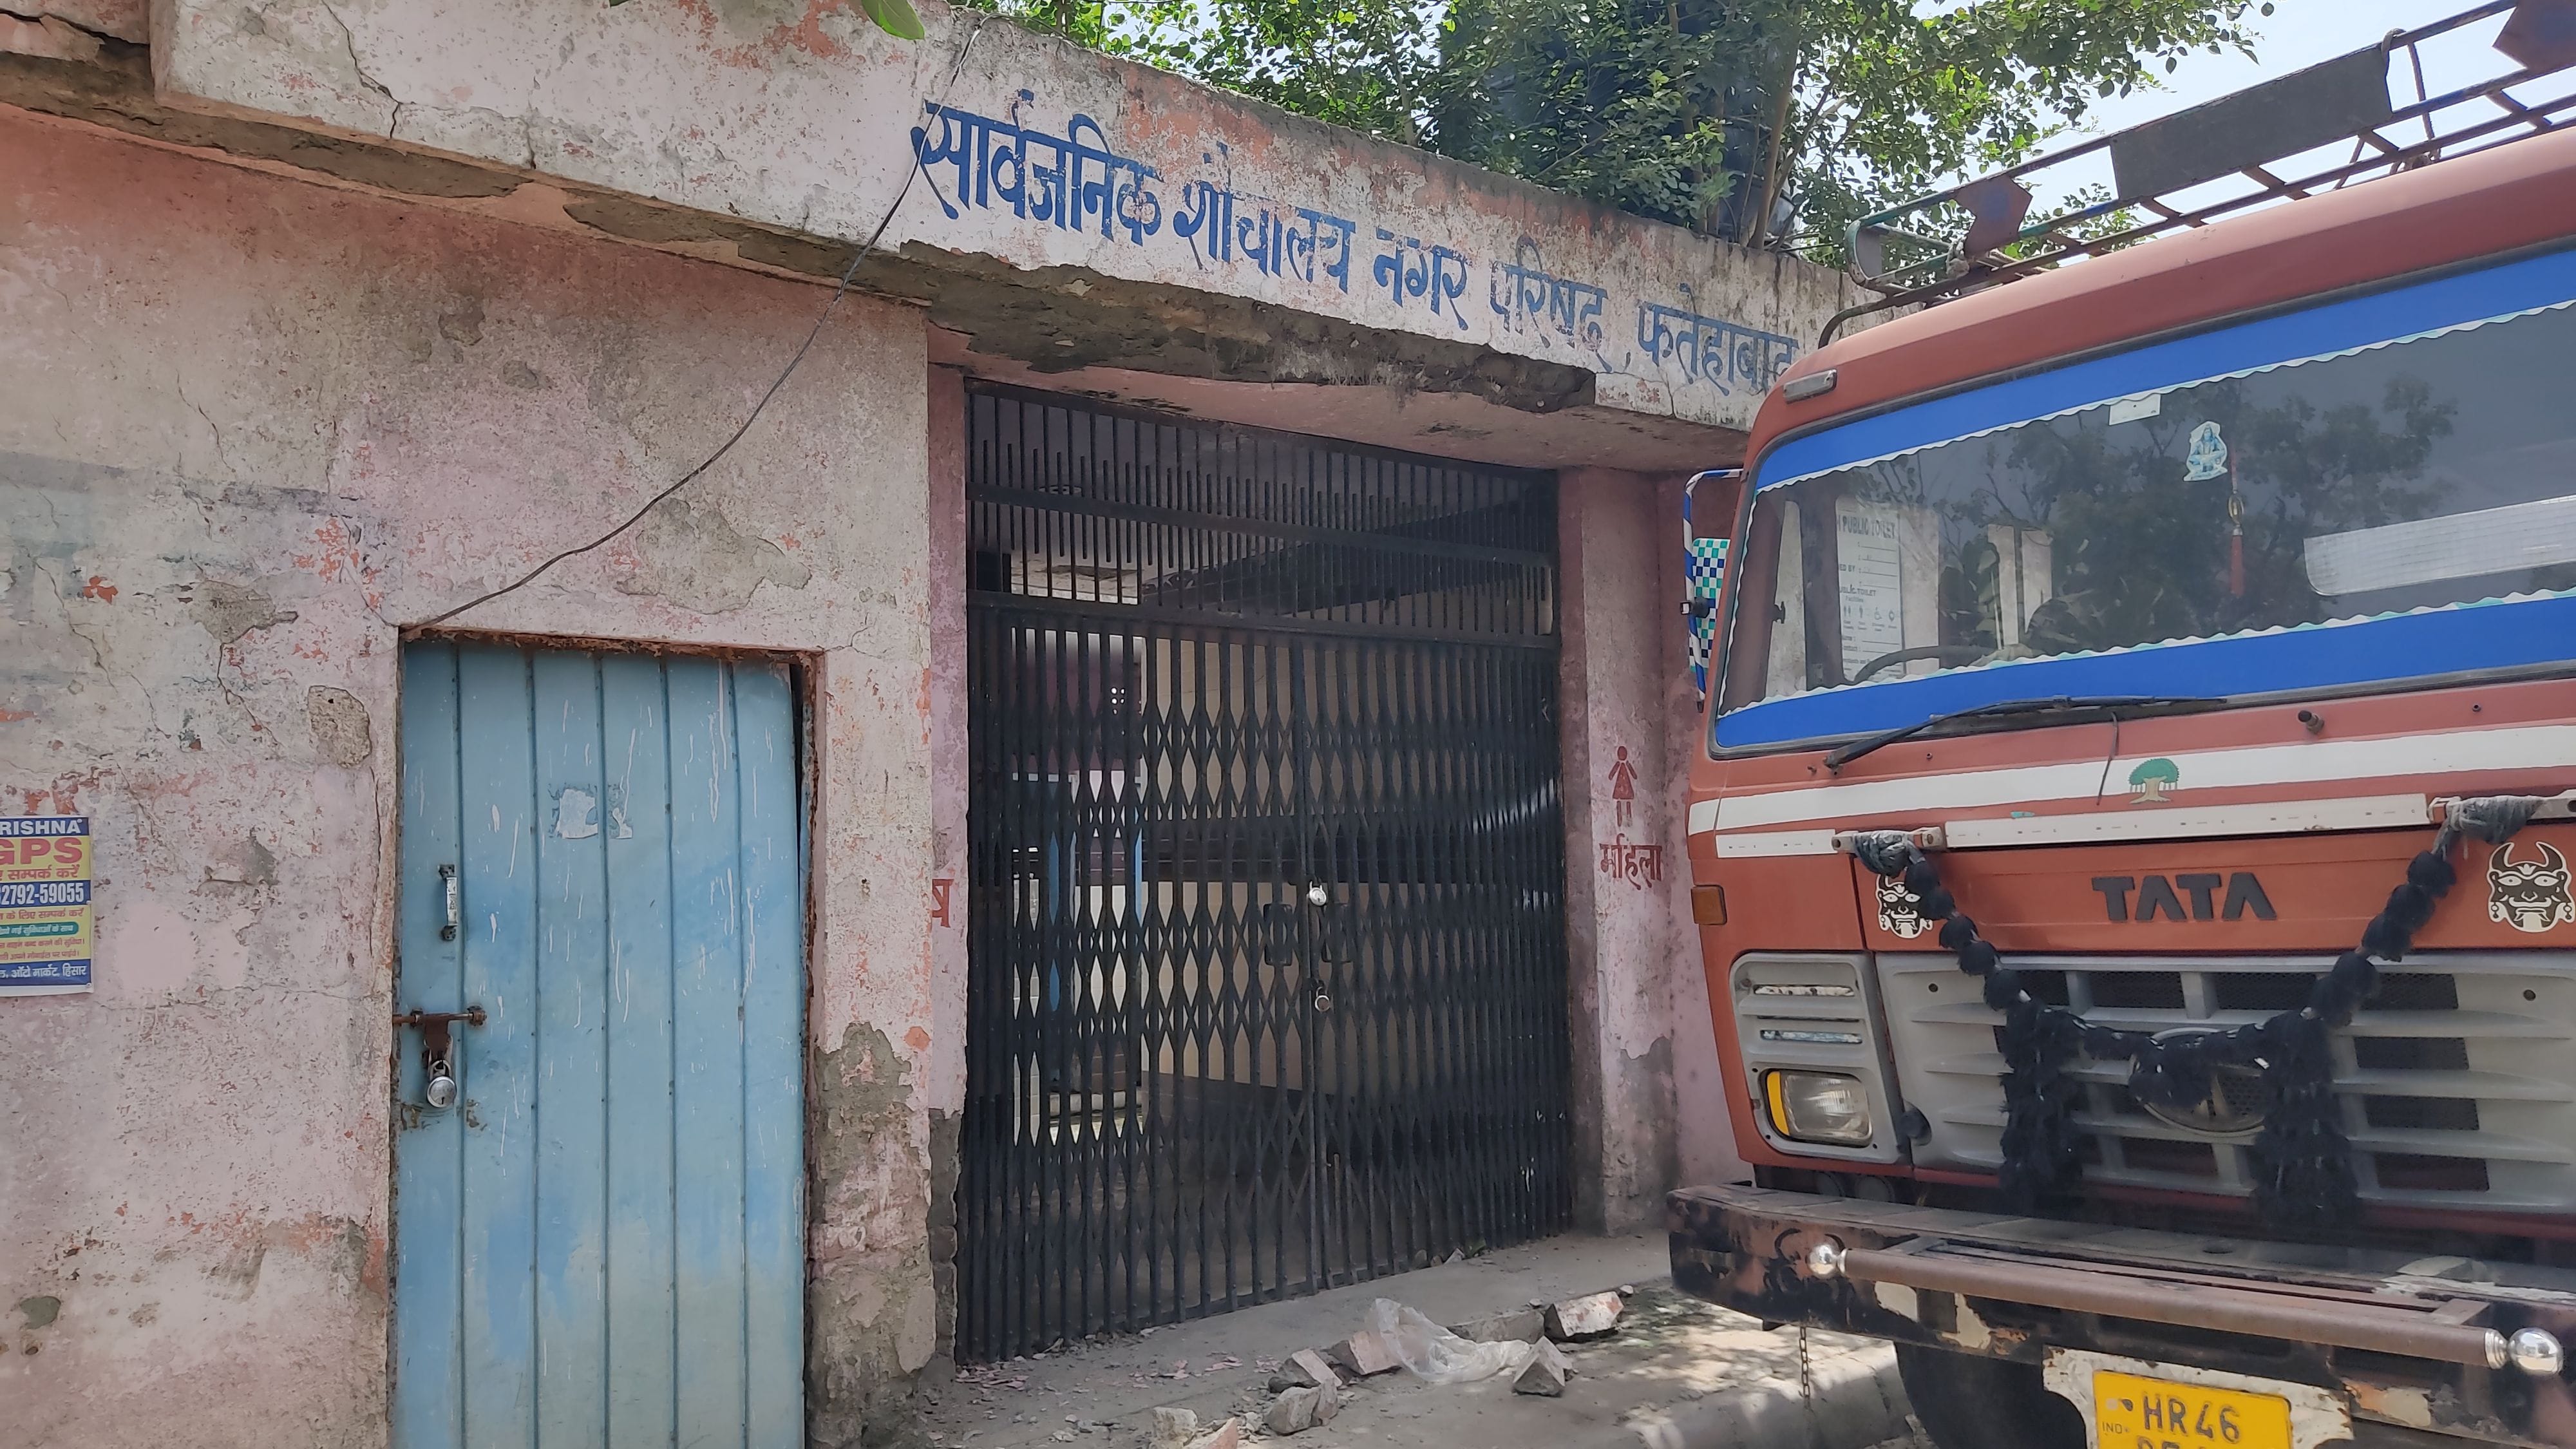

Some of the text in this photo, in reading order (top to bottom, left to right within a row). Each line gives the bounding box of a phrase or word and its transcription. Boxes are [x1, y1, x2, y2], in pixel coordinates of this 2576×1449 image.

[911, 89, 1163, 246] सार्वजनिक
[1373, 225, 1473, 331] नगर
[1842, 516, 1868, 536] PUBLIC
[8, 864, 52, 880] सम्पर्क
[56, 864, 80, 878] करें
[1599, 833, 1663, 891] महिला
[0, 884, 84, 905] 2792-59055
[2091, 871, 2278, 923] TATA
[62, 962, 88, 977] हिसार
[2142, 1391, 2241, 1444] HR46
